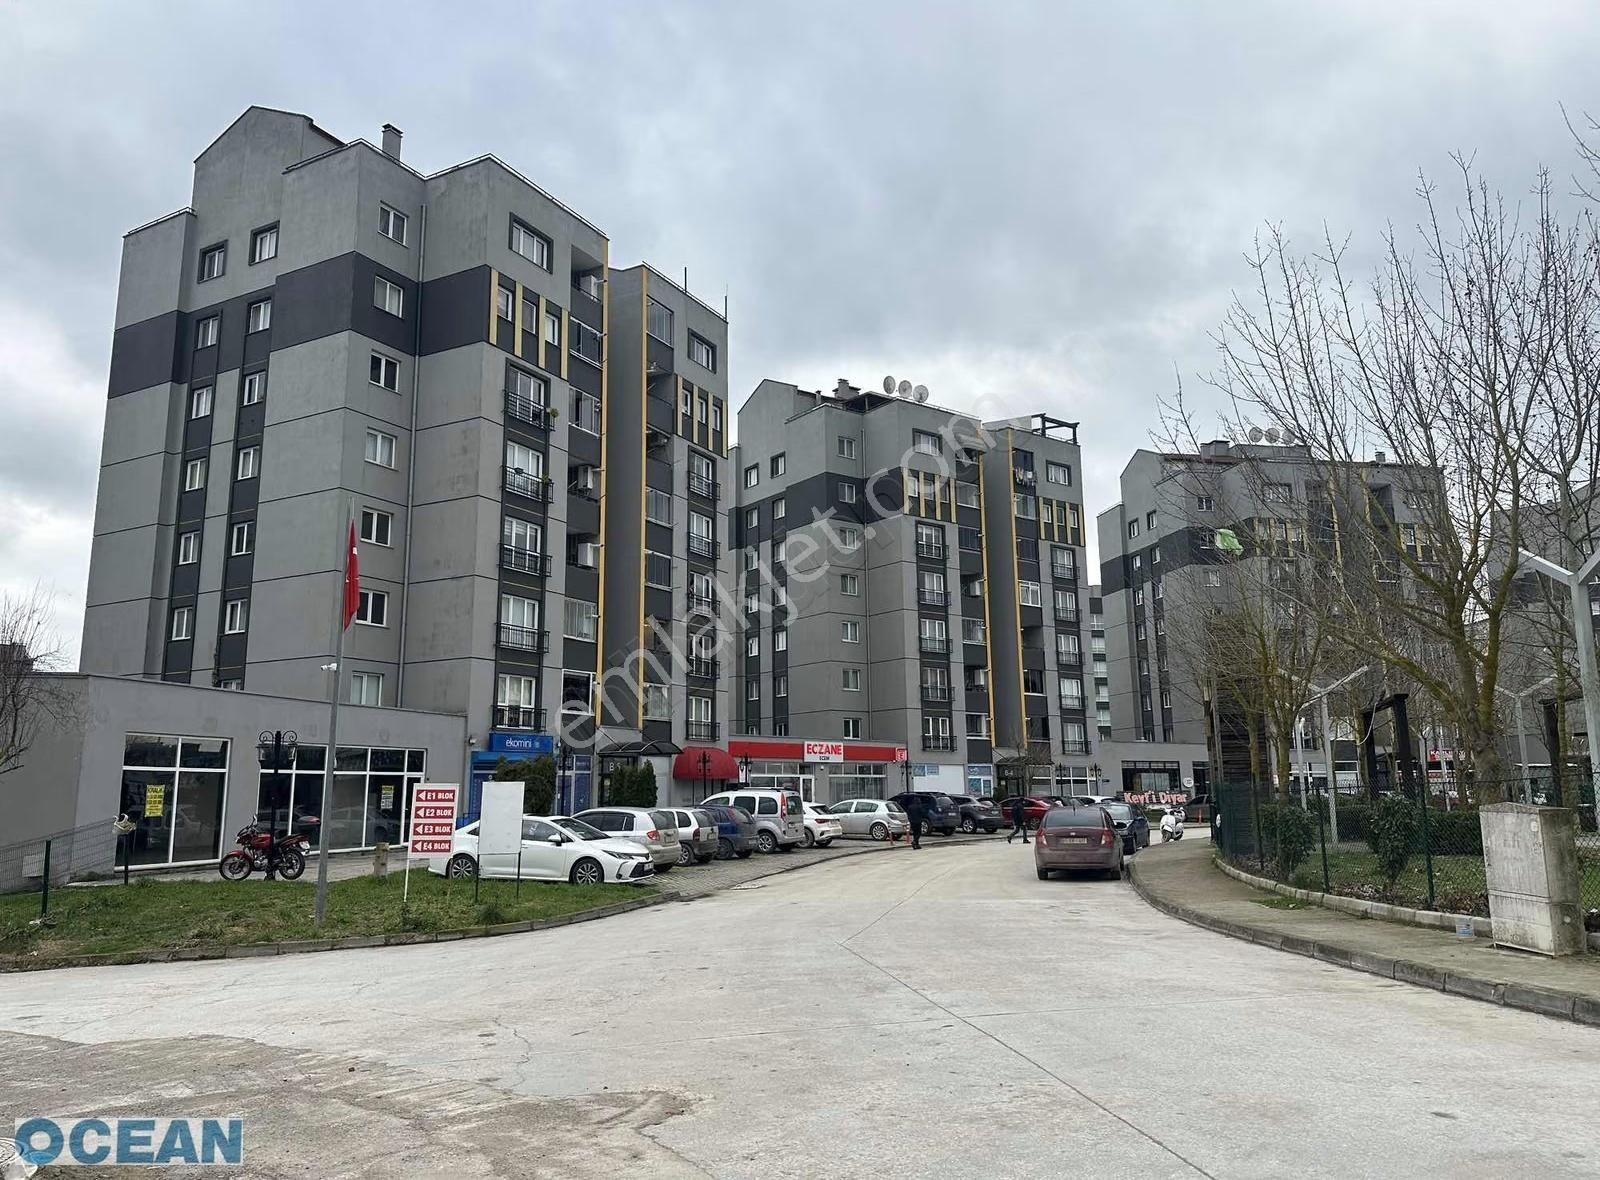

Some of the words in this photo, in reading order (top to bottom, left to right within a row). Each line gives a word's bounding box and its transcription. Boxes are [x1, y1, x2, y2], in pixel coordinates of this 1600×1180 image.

[506, 738, 532, 748] ekomini
[807, 744, 842, 755] ECZANE
[427, 792, 436, 800] E1
[437, 792, 454, 800] BLOK
[426, 808, 435, 817] E2
[424, 825, 434, 833] E3
[434, 825, 451, 833] BLOK
[423, 842, 433, 850] E4
[433, 842, 450, 850] BLOK
